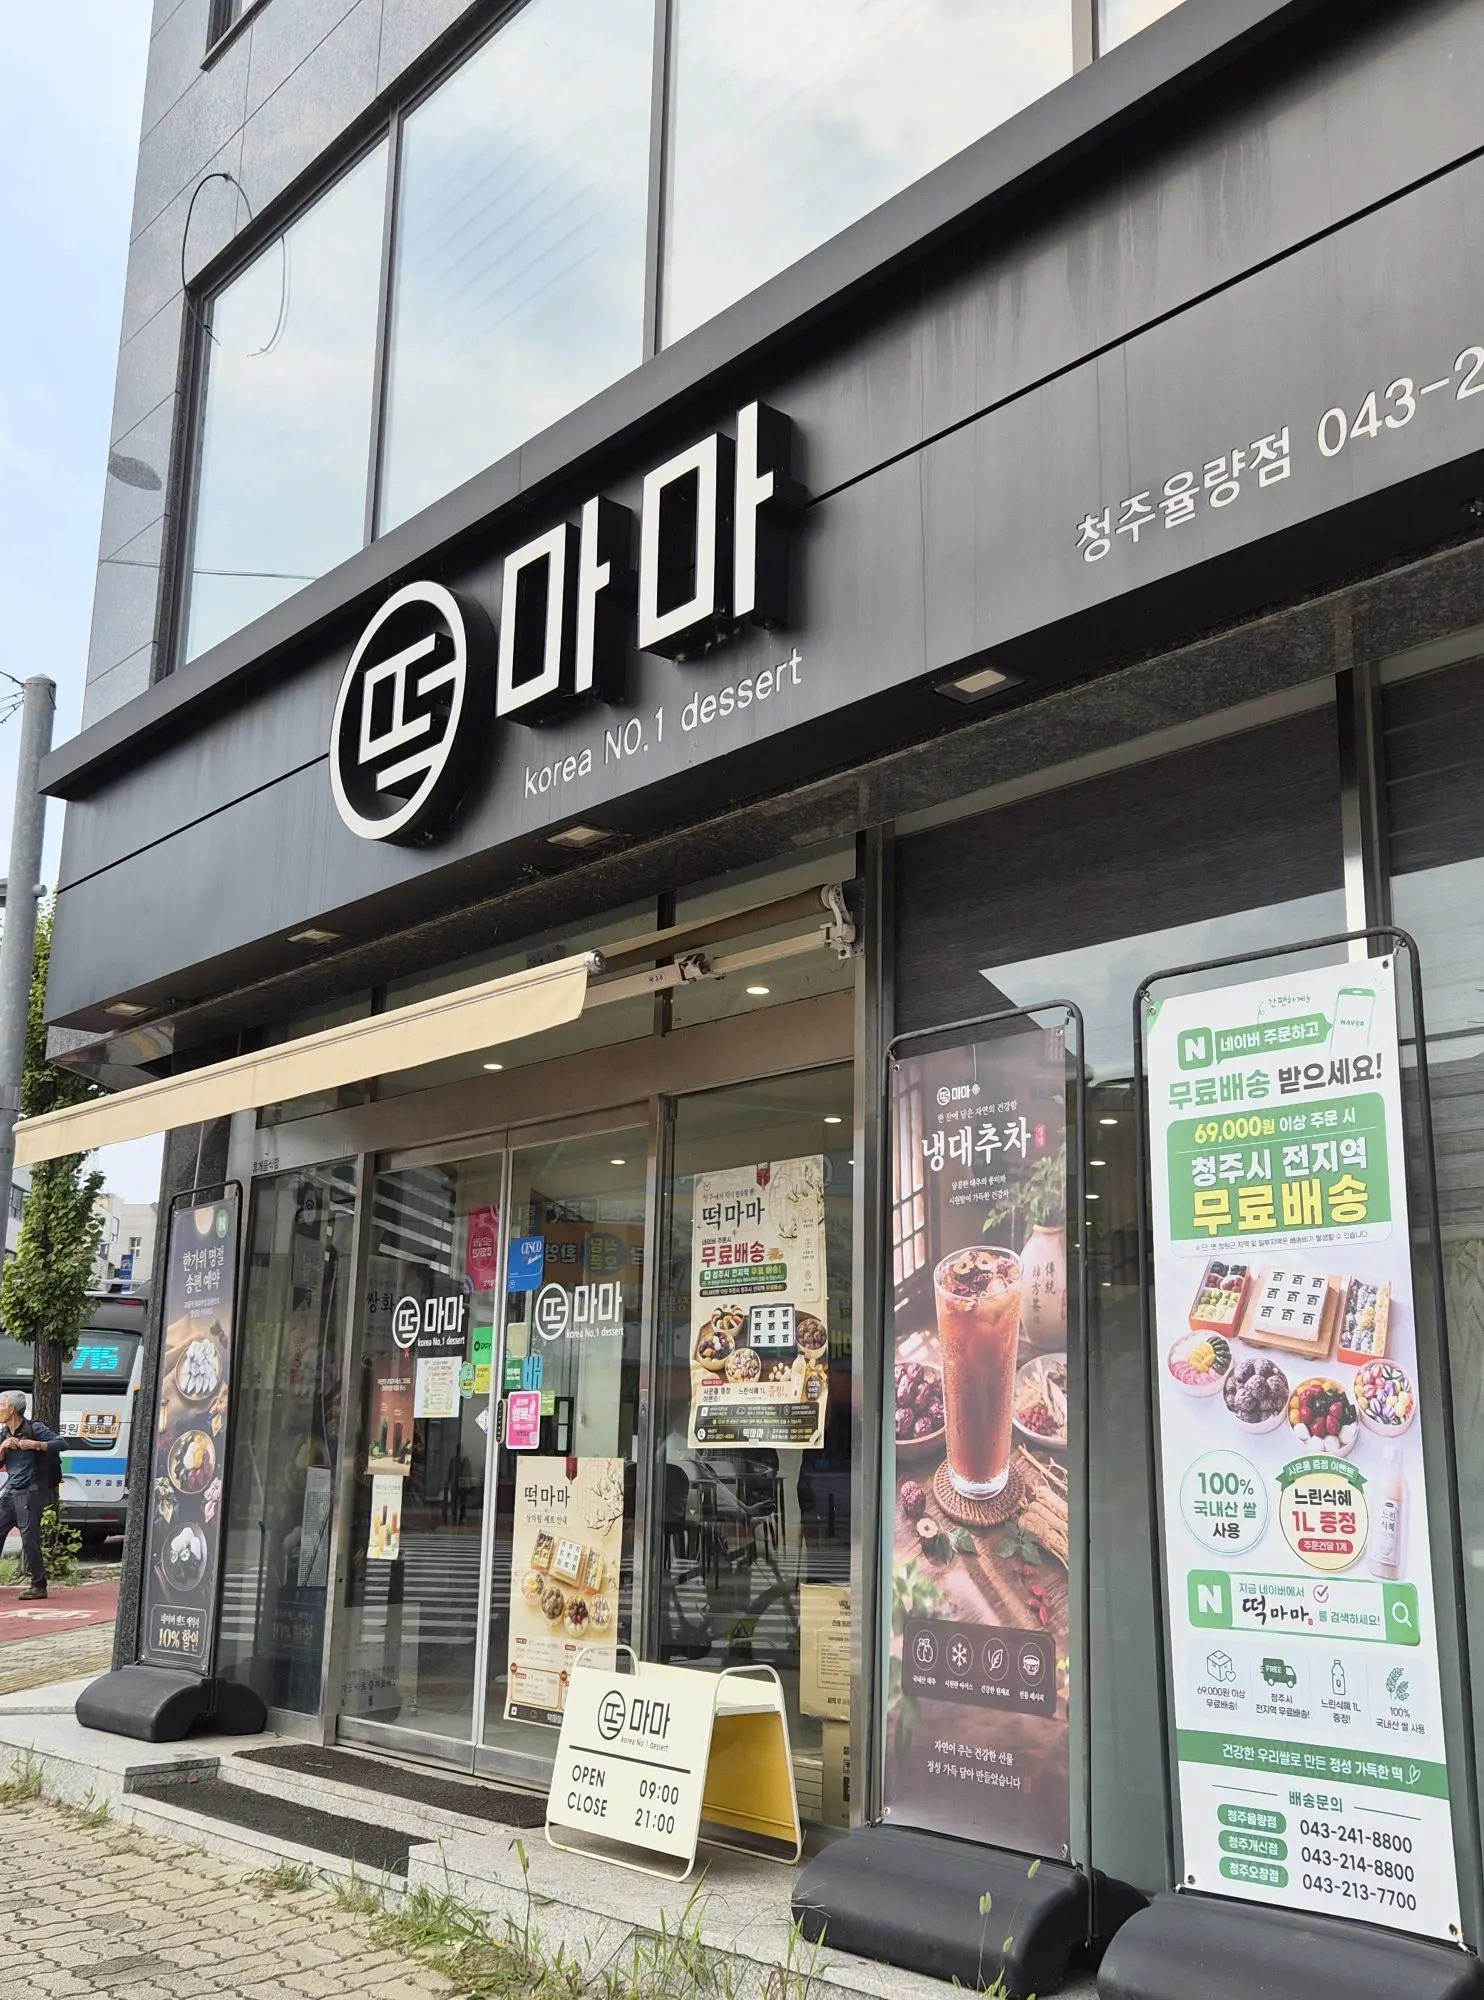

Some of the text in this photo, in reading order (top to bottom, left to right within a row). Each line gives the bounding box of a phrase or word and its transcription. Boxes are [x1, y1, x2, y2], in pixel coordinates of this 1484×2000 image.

[1076, 426, 1291, 562] 청주율량점
[524, 647, 803, 798] korea NO.1 dessert
[1185, 1037, 1206, 1061] N
[1220, 1022, 1319, 1052] 네이버 주문하고
[1168, 1052, 1382, 1110] 무료배송 받으세요!
[1194, 1107, 1356, 1144] 69,000원 이상 주문 시
[922, 1117, 1032, 1171] 냉대추차
[1191, 1137, 1367, 1187] 청주시 전지역
[702, 1197, 765, 1231] 떡마마
[1193, 1174, 1369, 1236] 무료배송
[216, 1216, 226, 1231] N
[182, 1245, 225, 1272] 한가위 명절
[521, 1241, 542, 1255] CESCO
[701, 1240, 765, 1267] 무료배송
[185, 1270, 221, 1295] 송편 예약
[417, 1337, 432, 1347] korea
[446, 1336, 465, 1346] dessert
[566, 1328, 583, 1339] korea
[601, 1326, 624, 1337] dessert
[1289, 1460, 1355, 1477] 사은품 증정 이벤트
[1198, 1472, 1254, 1496] 100%
[524, 1484, 571, 1509] 떡마마
[1295, 1488, 1352, 1506] 느린식혜
[1193, 1501, 1256, 1519] 국내산 쌀
[1212, 1522, 1240, 1539] 사용
[1292, 1511, 1356, 1534] 1L 증정
[1303, 1541, 1347, 1551] 주문건당 1개
[1197, 1584, 1222, 1613] N
[1239, 1583, 1304, 1598] 지금 네이버에서
[1242, 1595, 1309, 1626] 떡마마
[1330, 1612, 1380, 1627] 검색하세요!
[158, 1628, 199, 1652] 10% 할인
[1266, 1665, 1282, 1674] FREE
[1206, 1699, 1238, 1711] 무료배송!
[1231, 1688, 1246, 1699] 이상
[1270, 1693, 1293, 1704] 청주시
[1321, 1699, 1361, 1712] 느린식혜 1L
[1255, 1704, 1310, 1720] 전지역 무료배송!
[1332, 1712, 1351, 1724] 증정!
[1389, 1706, 1410, 1718] 100%
[1376, 1718, 1399, 1731] 국내산
[1411, 1723, 1425, 1735] 사용
[621, 1736, 668, 1752] korea dessert
[934, 1741, 1014, 1766] 자연이 주는 건강한 선물
[1222, 1743, 1403, 1782] 건강한 우리쌀로 만든 정성 가득한 떡
[571, 1764, 679, 1806] OPEN 09:00
[927, 1760, 1021, 1790] 정성 가득 담아 만들었습니다
[567, 1791, 675, 1835] CLOSE 21:00
[1289, 1790, 1343, 1813] 배송문의
[1227, 1810, 1413, 1854] 청주율량점 043-241-8800
[1228, 1836, 1415, 1883] 청주개신점 043-214-8800
[1229, 1863, 1416, 1911] 청주오창점 043-213-7700
